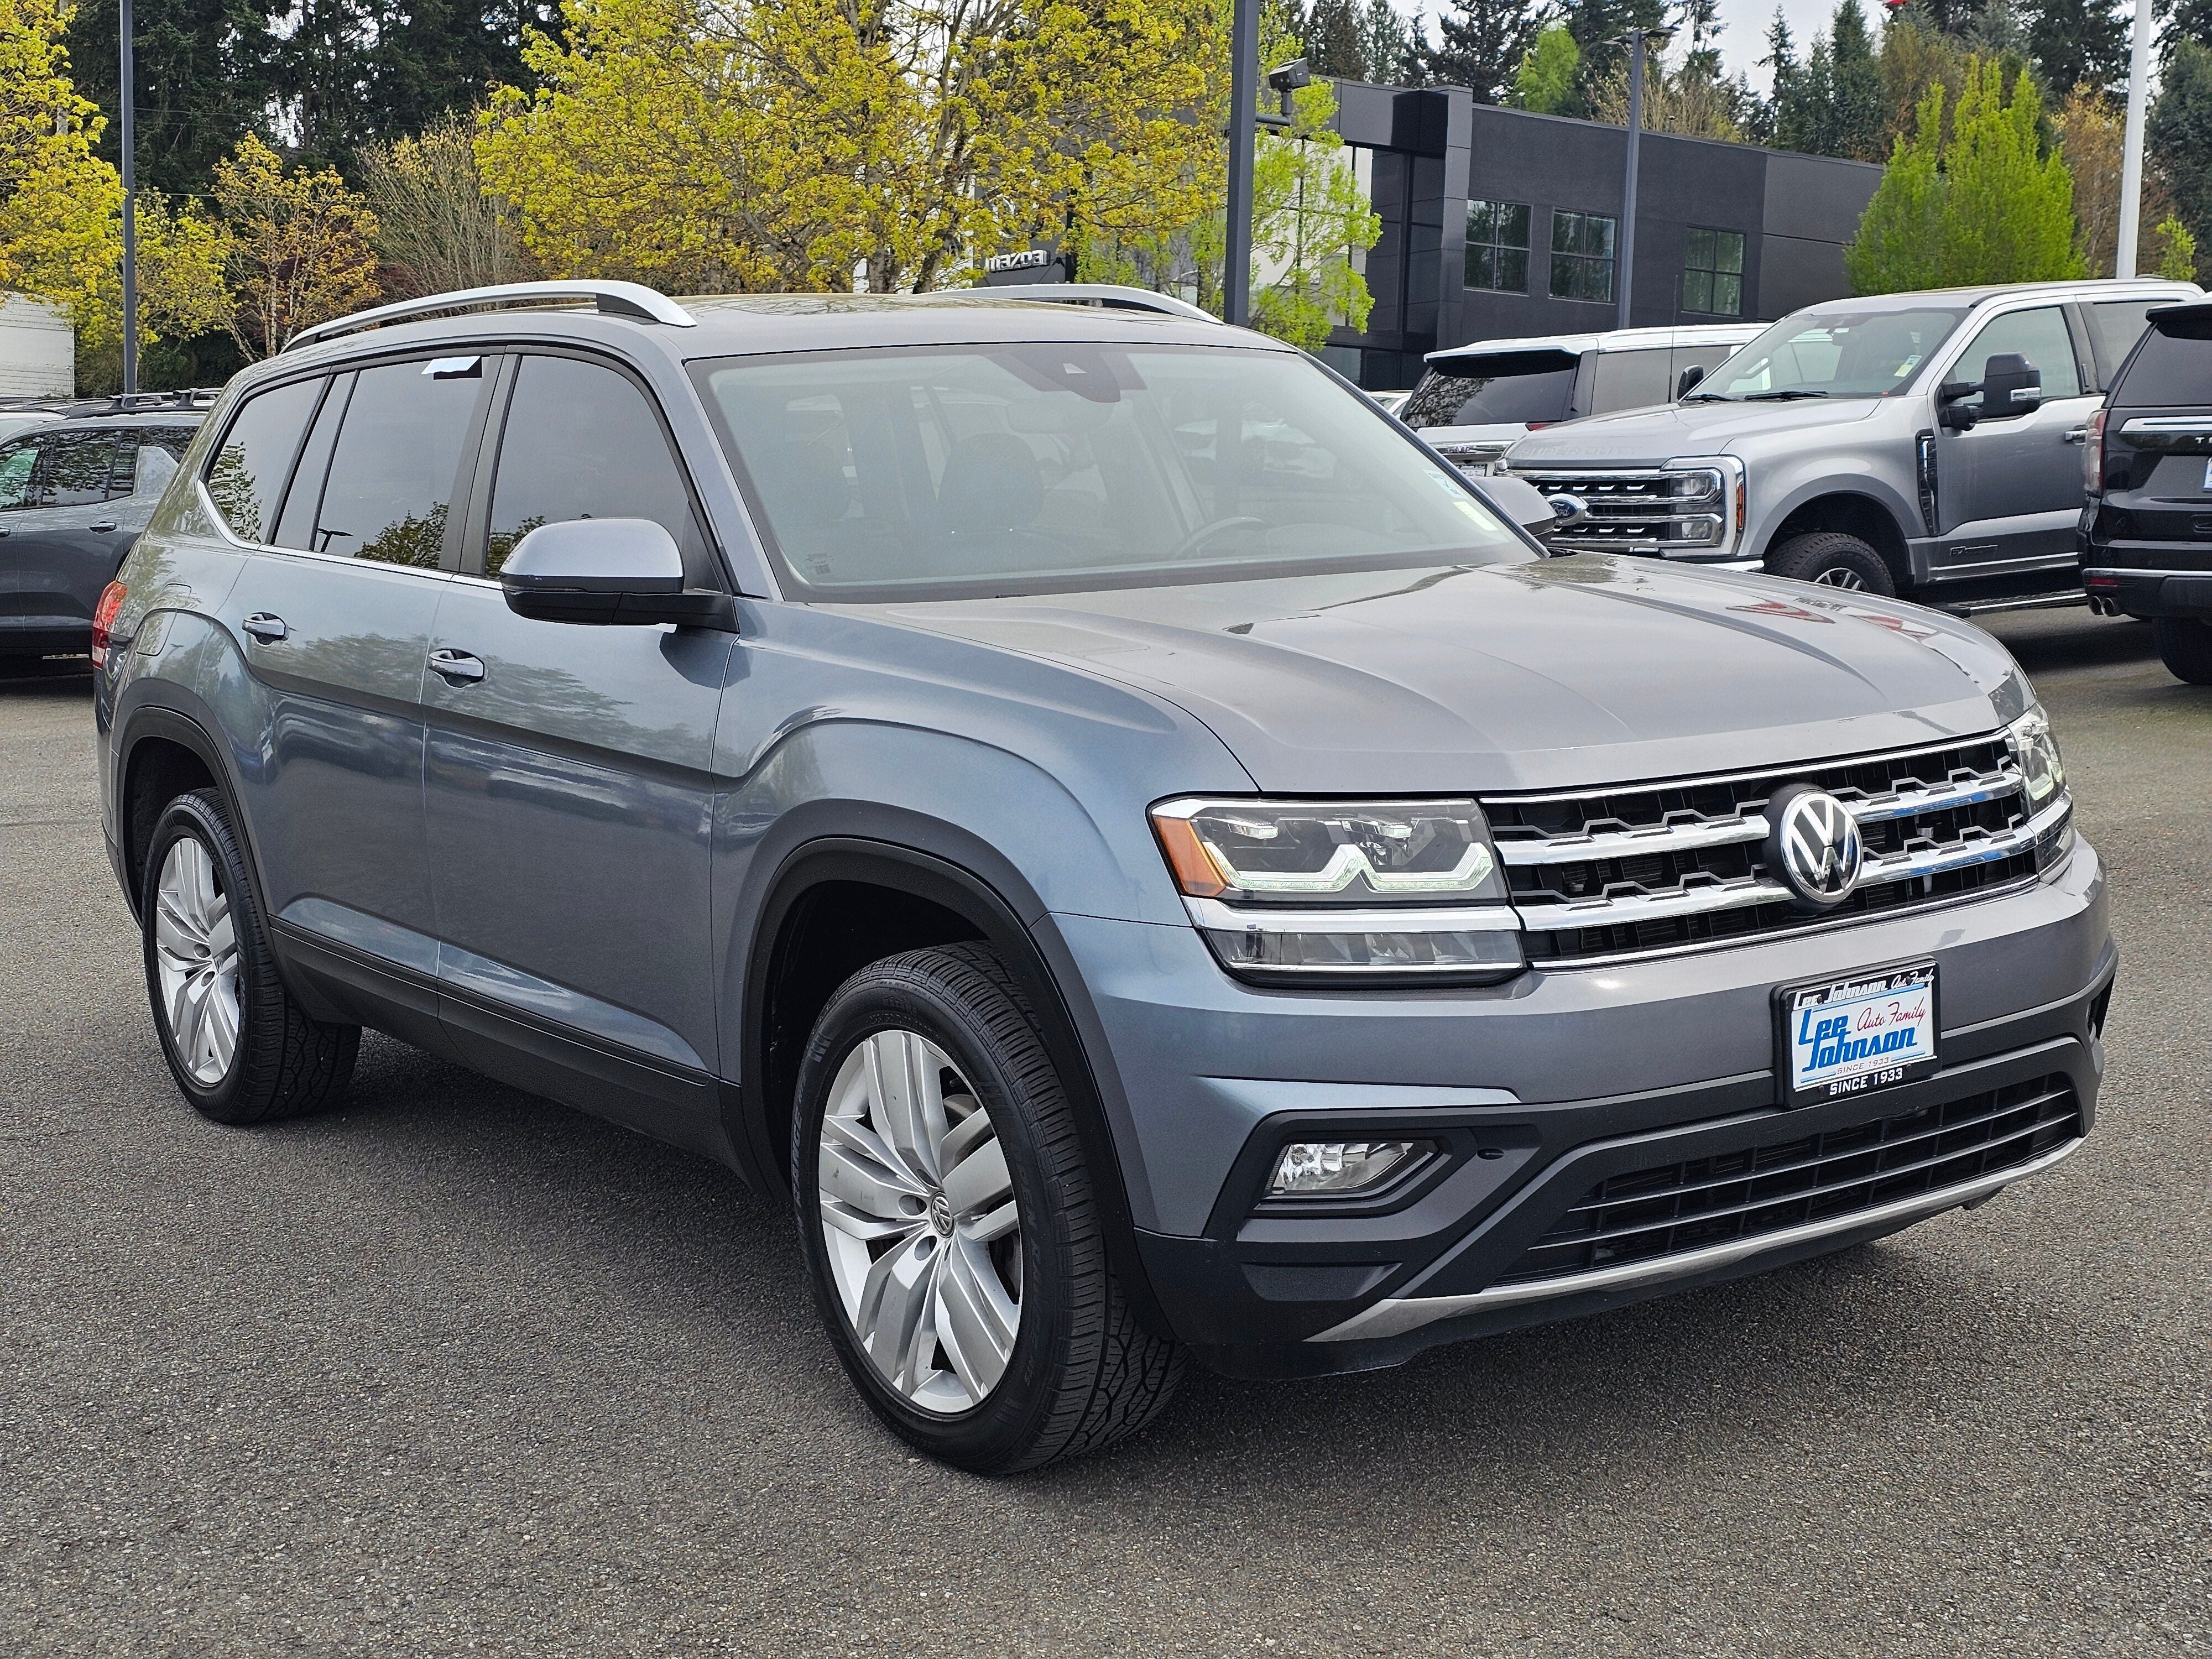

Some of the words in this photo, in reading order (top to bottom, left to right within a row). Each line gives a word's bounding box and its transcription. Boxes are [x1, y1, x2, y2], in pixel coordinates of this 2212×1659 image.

[1824, 980, 1888, 1004] Johnson
[1798, 1009, 1852, 1045] Lee
[1857, 1007, 1886, 1031] Auto
[1887, 997, 1927, 1027] Family
[1801, 1026, 1918, 1072] Johnson
[1829, 1078, 1868, 1096] SINCE
[1872, 1067, 1903, 1086] 1933
[1837, 1062, 1865, 1075] SINCE
[1868, 1057, 1890, 1068] 1933
